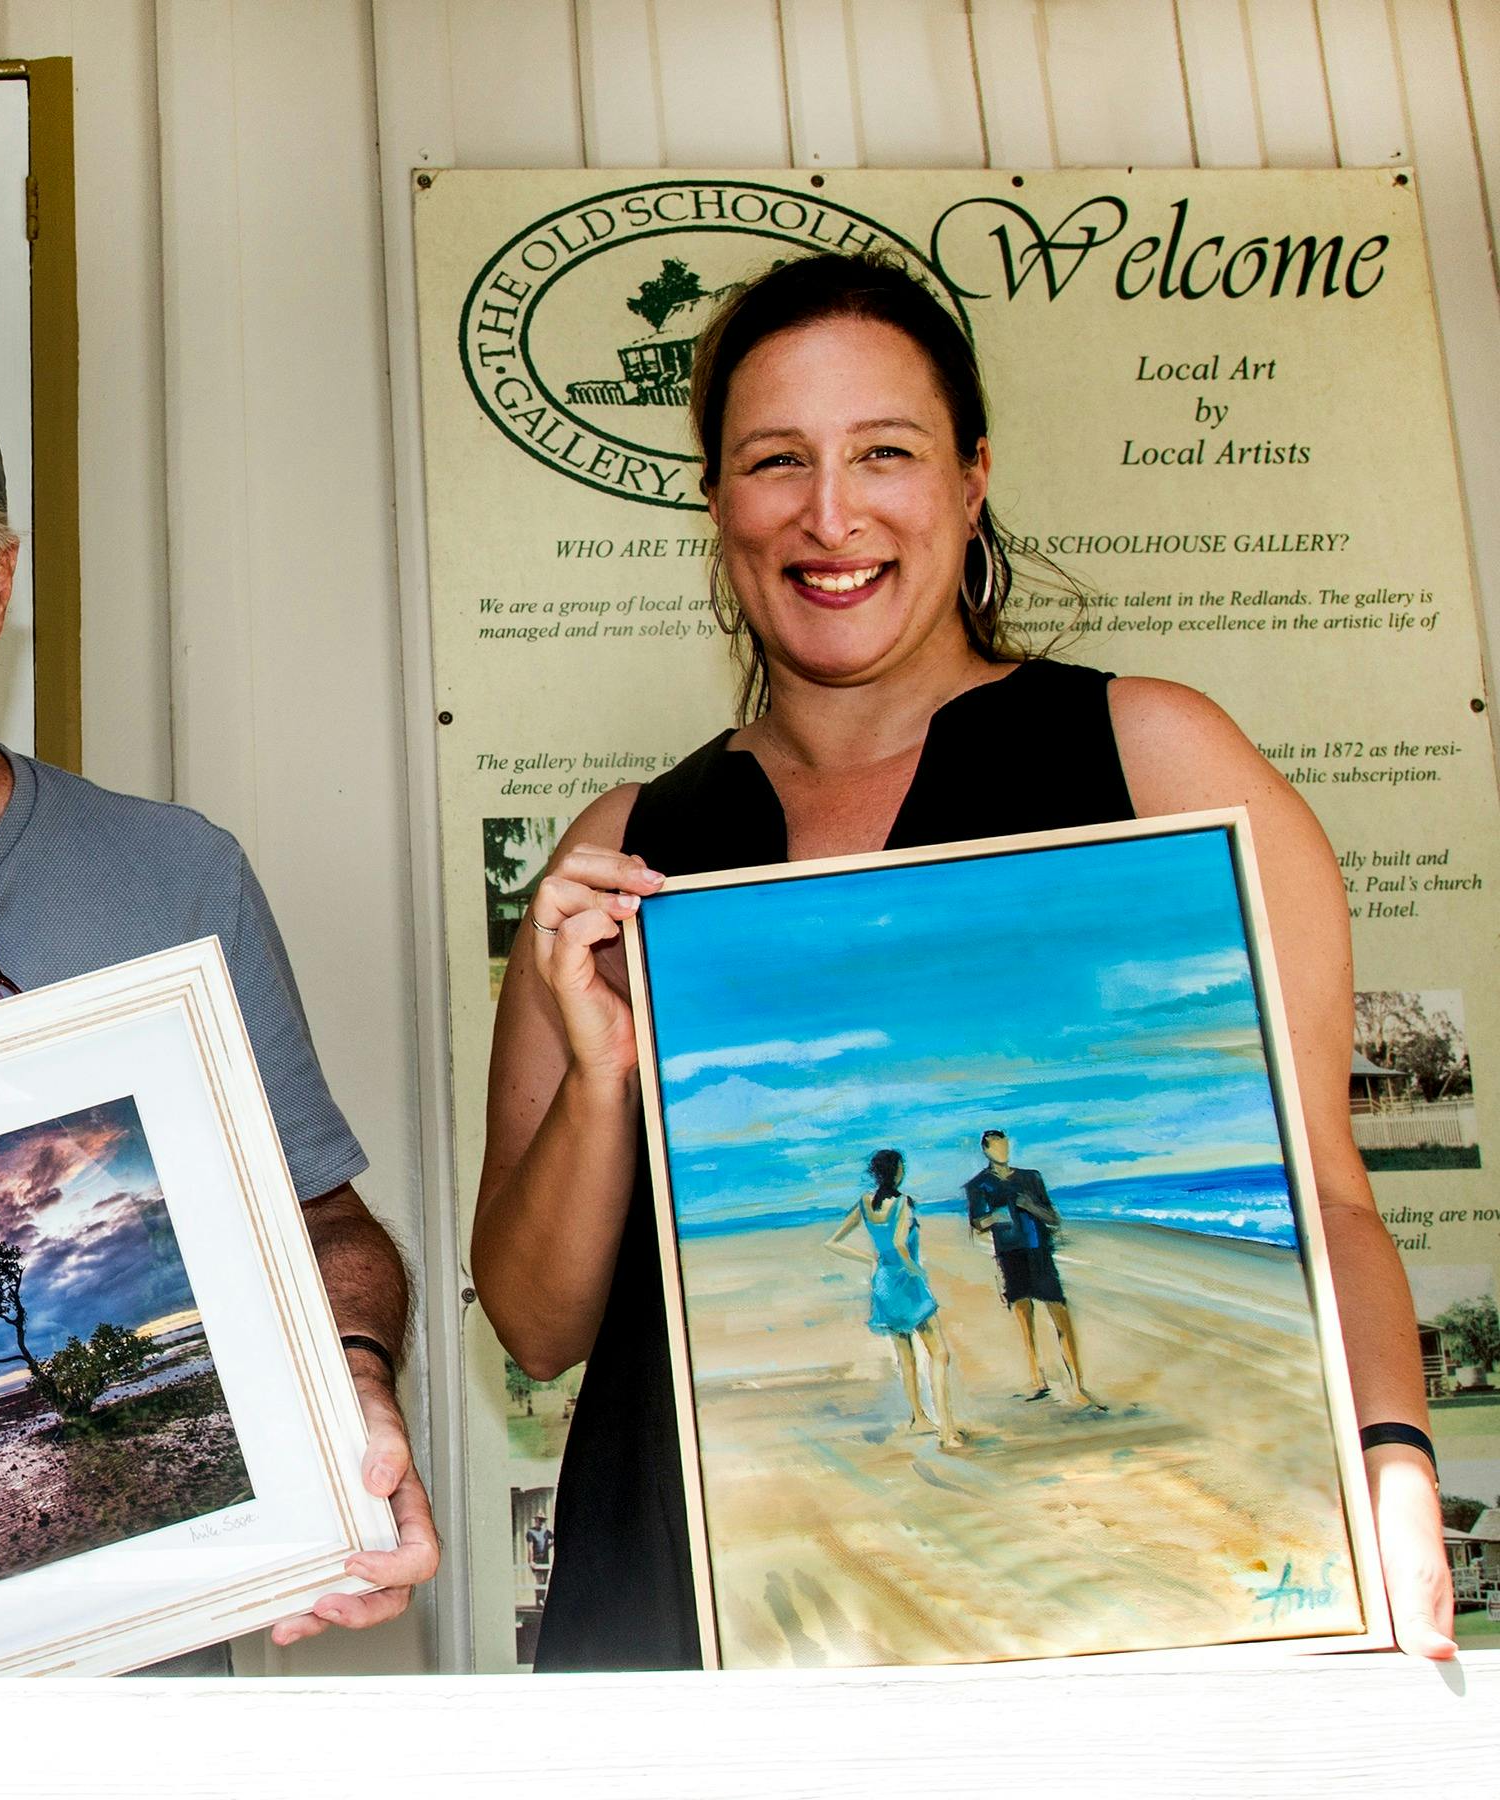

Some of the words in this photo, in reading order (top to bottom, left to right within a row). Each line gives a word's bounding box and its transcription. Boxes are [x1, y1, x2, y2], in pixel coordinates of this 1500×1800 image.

[930, 196, 1389, 302] Welcome
[477, 271, 532, 367] THE
[521, 208, 616, 271] OLD
[1136, 354, 1220, 382] Local
[1229, 354, 1277, 382] Art
[1194, 396, 1230, 430] by
[1120, 439, 1206, 466] Local
[1214, 439, 1312, 466] Artists
[555, 538, 615, 558] WHO
[619, 538, 669, 558] ARE
[1000, 534, 1040, 555] LD
[1045, 534, 1227, 555] SCHOOLHOUSE
[1233, 533, 1351, 554] GALLERY?
[478, 597, 505, 614] We
[508, 602, 538, 614] are
[542, 602, 555, 614] a
[558, 601, 611, 618] group
[615, 596, 636, 616] of
[638, 596, 683, 613] local
[1024, 592, 1054, 612] for
[1060, 591, 1120, 608] artistic
[1124, 590, 1173, 607] talent
[1177, 591, 1194, 607] in
[1198, 590, 1226, 607] the
[1229, 589, 1313, 607] Redlands.
[1318, 589, 1350, 606] The
[1354, 587, 1416, 609] gallery
[1419, 588, 1434, 604] is
[478, 623, 560, 642] managed
[564, 622, 599, 638] and
[603, 624, 634, 638] run
[638, 619, 692, 640] solely
[696, 620, 717, 640] by
[1001, 619, 1066, 634] romote
[1070, 615, 1103, 633] and
[1106, 614, 1174, 636] develop
[1178, 613, 1267, 632] excellence
[1271, 614, 1288, 631] in
[1292, 613, 1319, 631] the
[1323, 612, 1384, 630] artistic
[1388, 611, 1416, 632] life
[1419, 611, 1441, 632] of
[1258, 742, 1295, 759] built
[1300, 743, 1317, 758] in
[1323, 742, 1364, 759] 1872
[1368, 746, 1388, 758] as
[1393, 740, 1420, 758] the
[1424, 740, 1463, 757] resi-
[476, 753, 509, 770] The
[512, 753, 578, 775] gallery
[582, 751, 657, 772] building
[662, 752, 677, 768] is
[1285, 766, 1327, 784] ublic
[1331, 764, 1442, 787] subscription.
[500, 779, 554, 796] dence
[557, 778, 581, 799] of
[581, 777, 608, 794] the
[1337, 850, 1367, 872] ally
[1371, 850, 1412, 867] built
[1415, 848, 1450, 866] and
[1365, 874, 1419, 892] Paul's
[1422, 872, 1483, 891] church
[1366, 900, 1419, 919] Hotel.
[1381, 1205, 1434, 1228] siding
[1438, 1209, 1468, 1222] are
